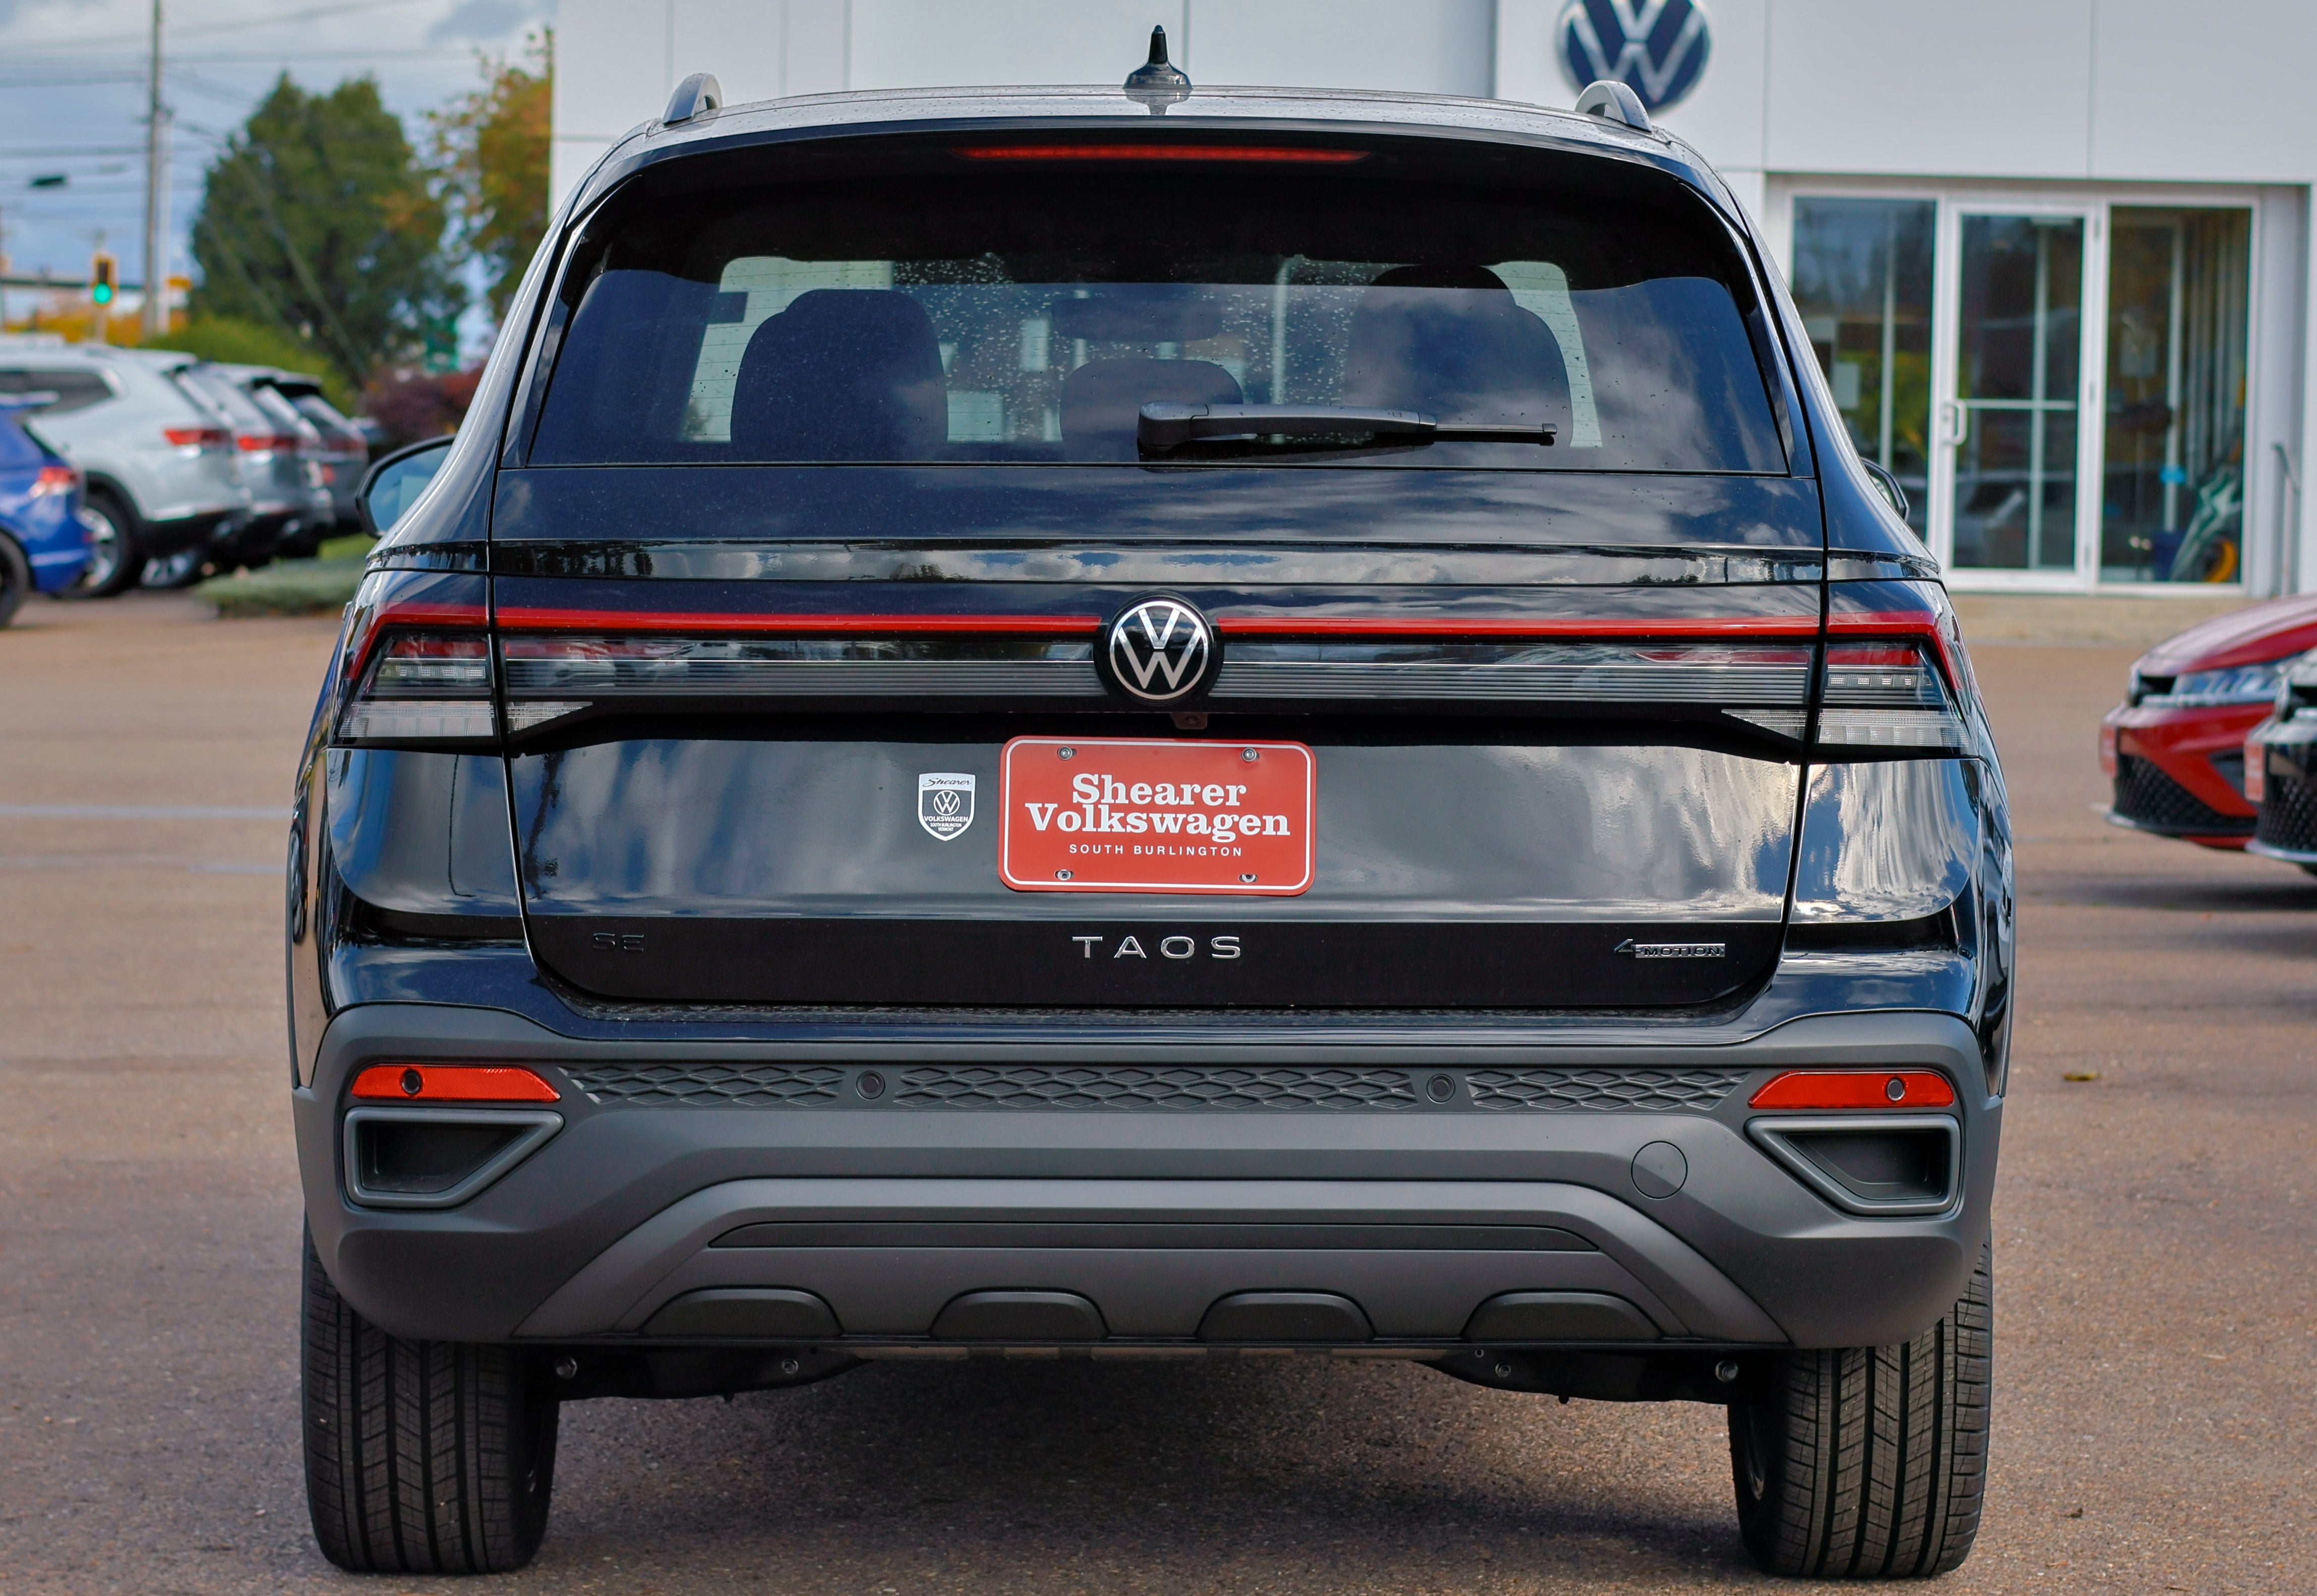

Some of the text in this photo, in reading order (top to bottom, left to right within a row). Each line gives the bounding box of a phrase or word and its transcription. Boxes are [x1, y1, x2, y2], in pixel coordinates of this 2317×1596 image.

[1111, 602, 1207, 698] VW
[922, 777, 972, 787] Shearer
[1072, 773, 1247, 806] Shearer
[934, 791, 959, 815] VW
[1025, 803, 1290, 843] Volkswagen
[1069, 844, 1242, 857] SOUTH BURLINGTON
[593, 933, 644, 952] SE
[1072, 936, 1241, 959] TAOS
[1614, 939, 1723, 957] 4MOTION
